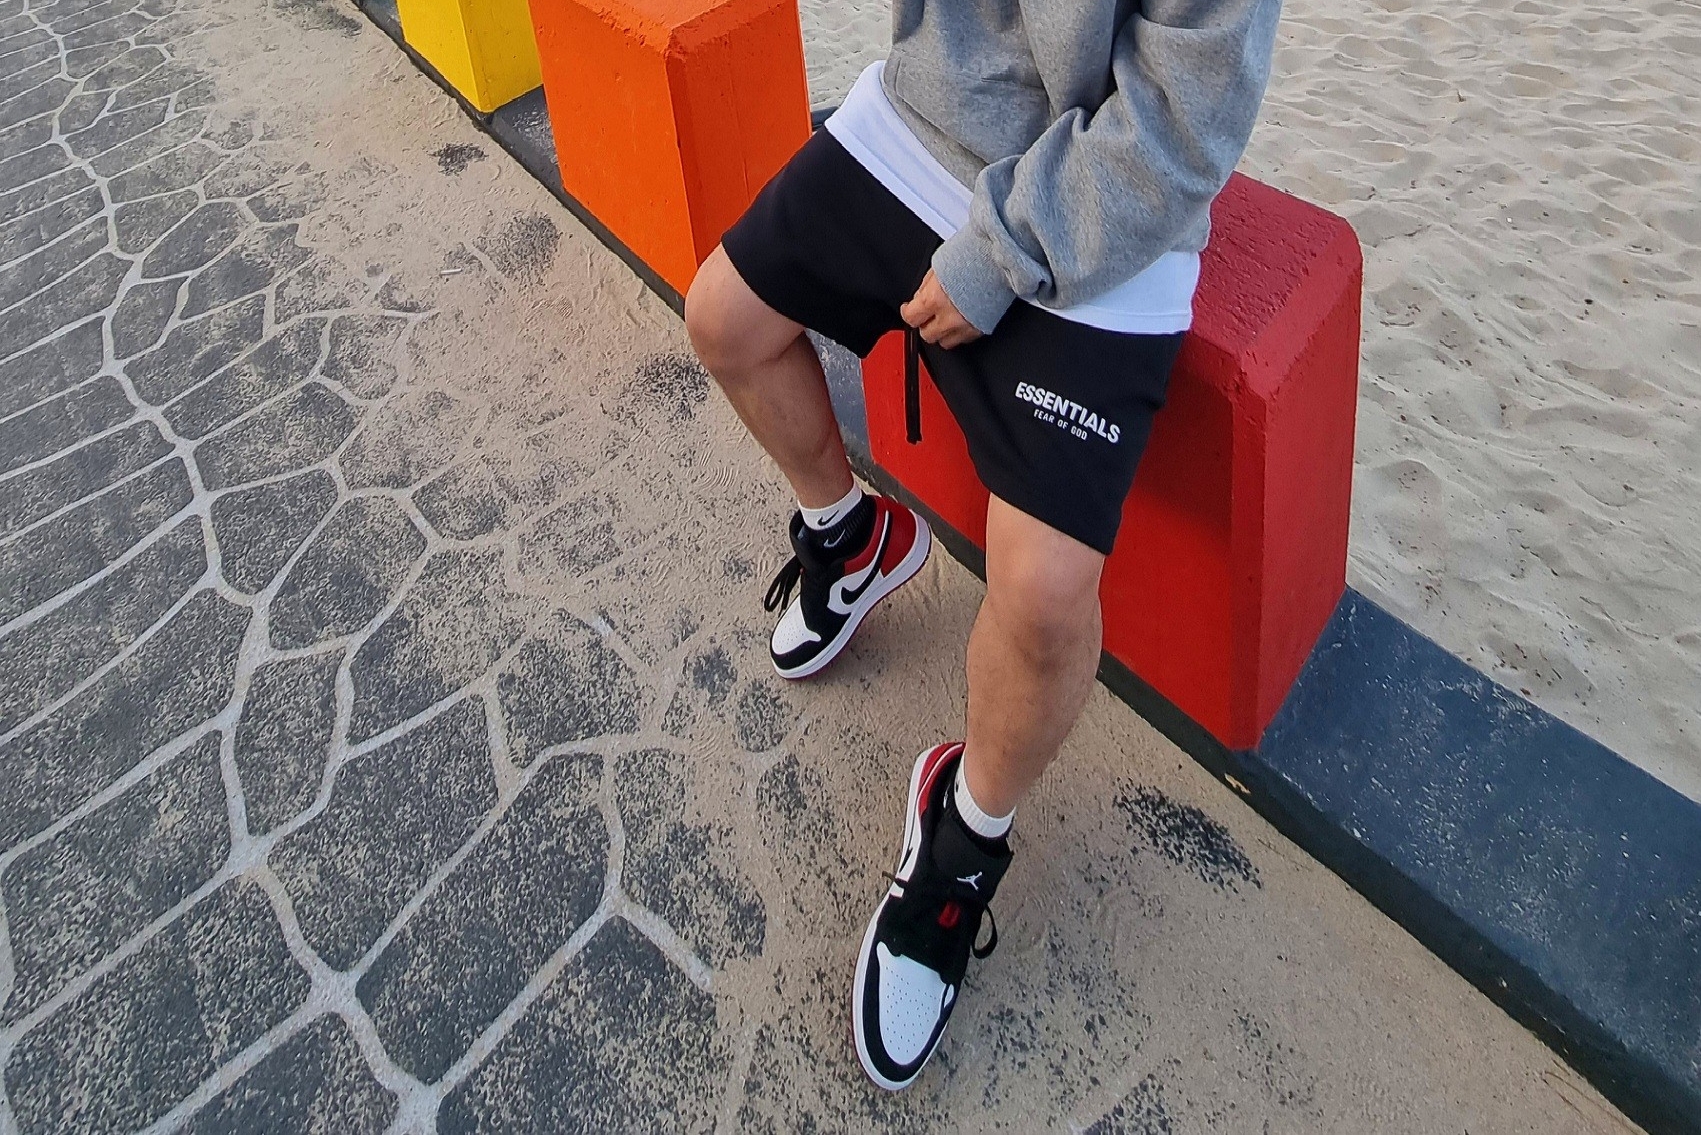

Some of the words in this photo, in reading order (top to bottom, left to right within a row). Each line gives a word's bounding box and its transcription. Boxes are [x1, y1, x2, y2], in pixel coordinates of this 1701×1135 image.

[1015, 381, 1121, 444] ESSENTIALS
[1033, 408, 1055, 424] FEAR
[1057, 419, 1069, 430] OF
[1070, 425, 1088, 441] GOD
